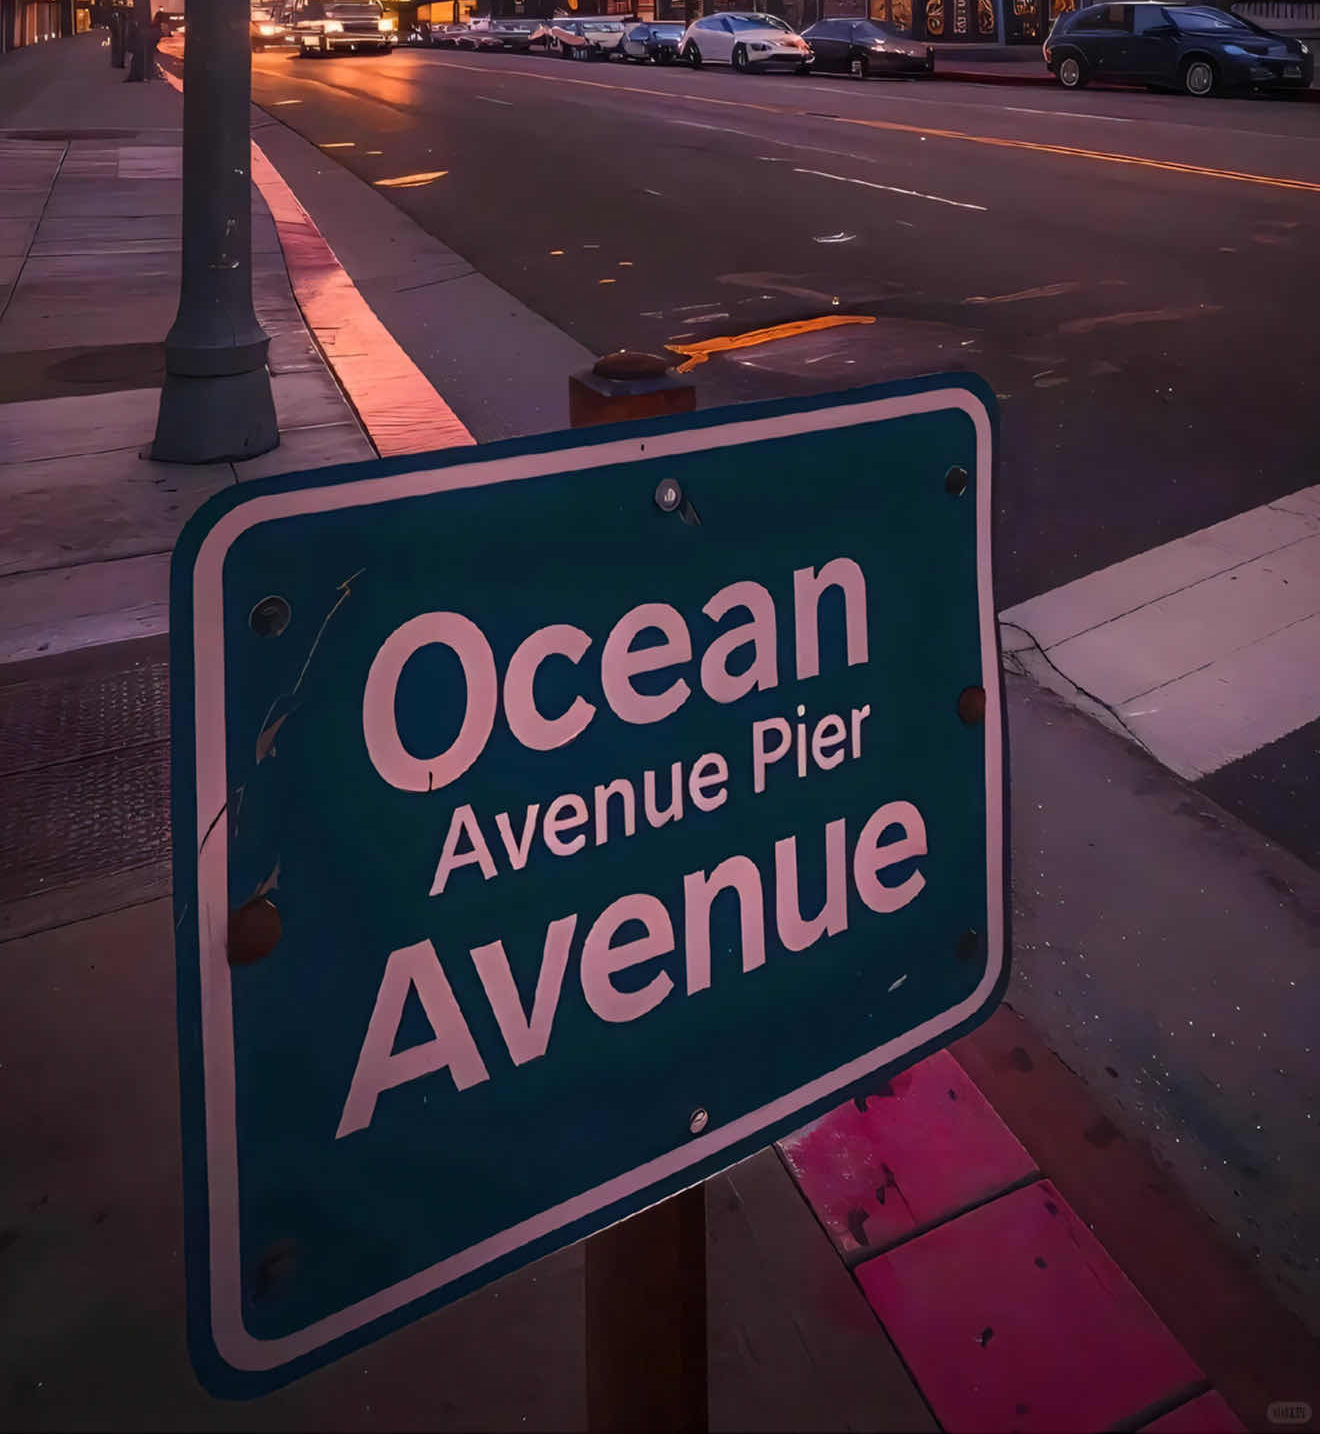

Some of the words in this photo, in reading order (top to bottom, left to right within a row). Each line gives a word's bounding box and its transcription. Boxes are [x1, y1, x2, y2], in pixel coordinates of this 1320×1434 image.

[363, 557, 869, 792] Ocean
[428, 751, 729, 896] Avenue
[753, 705, 872, 793] Pier
[335, 801, 928, 1140] Avenue
